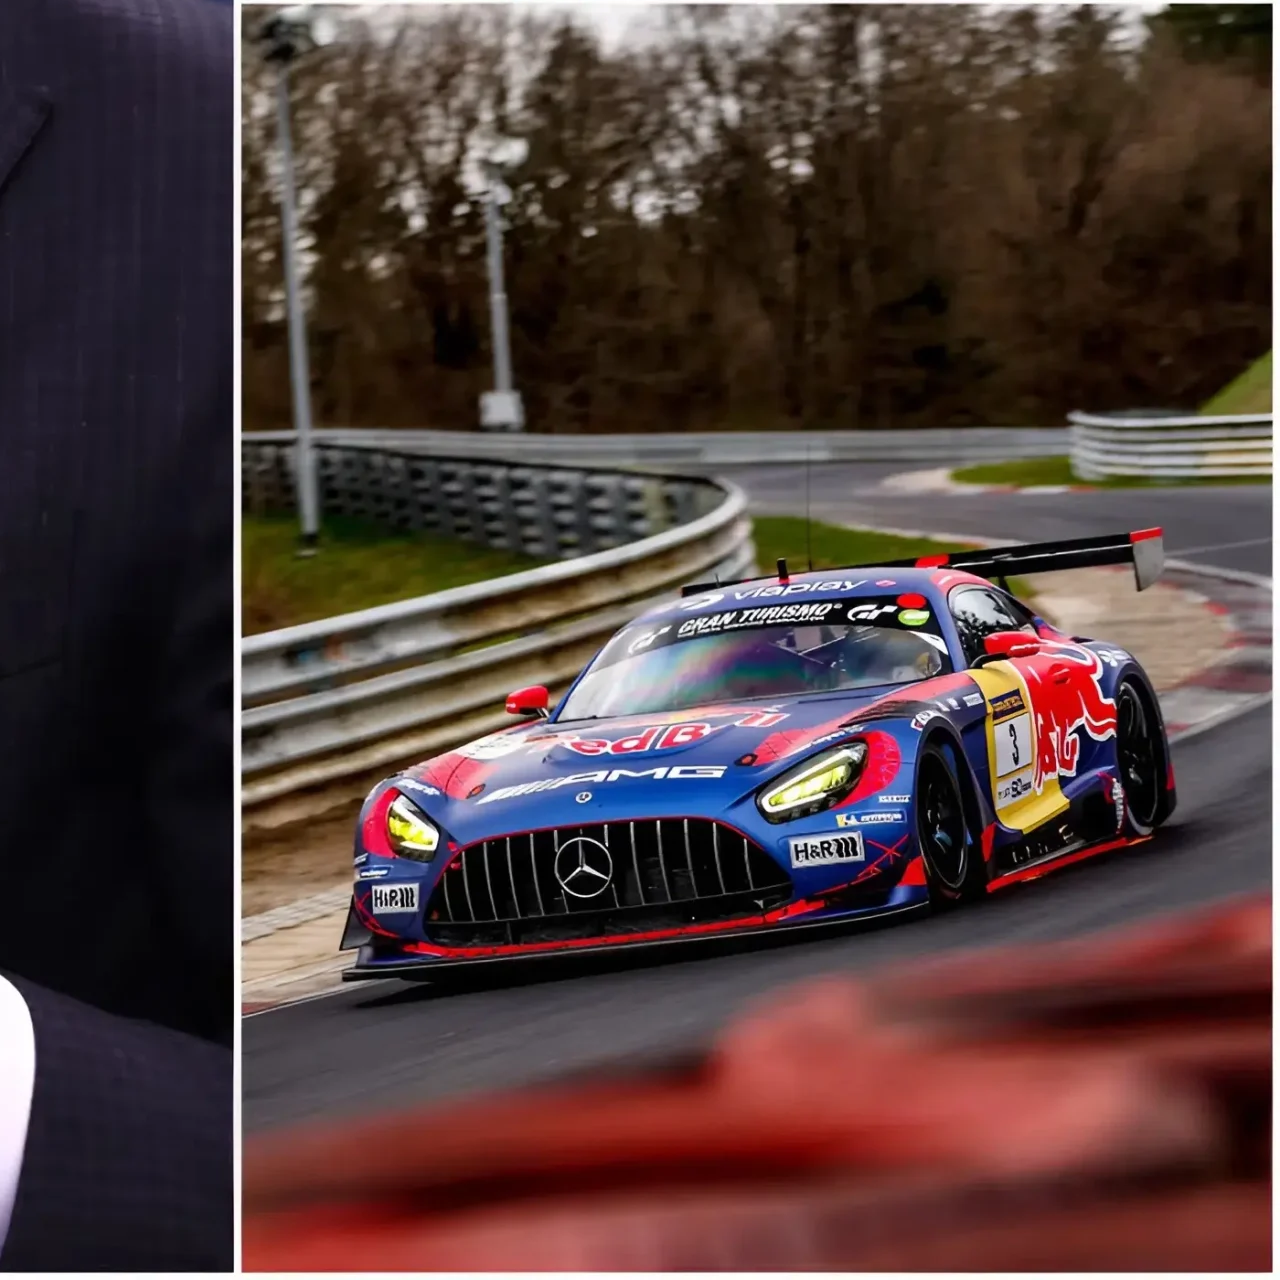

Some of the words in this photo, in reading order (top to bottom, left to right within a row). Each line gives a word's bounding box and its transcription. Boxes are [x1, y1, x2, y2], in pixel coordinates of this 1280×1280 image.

[734, 578, 870, 601] viaplay
[1008, 723, 1020, 766] 3
[554, 765, 728, 788] AMG
[793, 840, 836, 863] H&R
